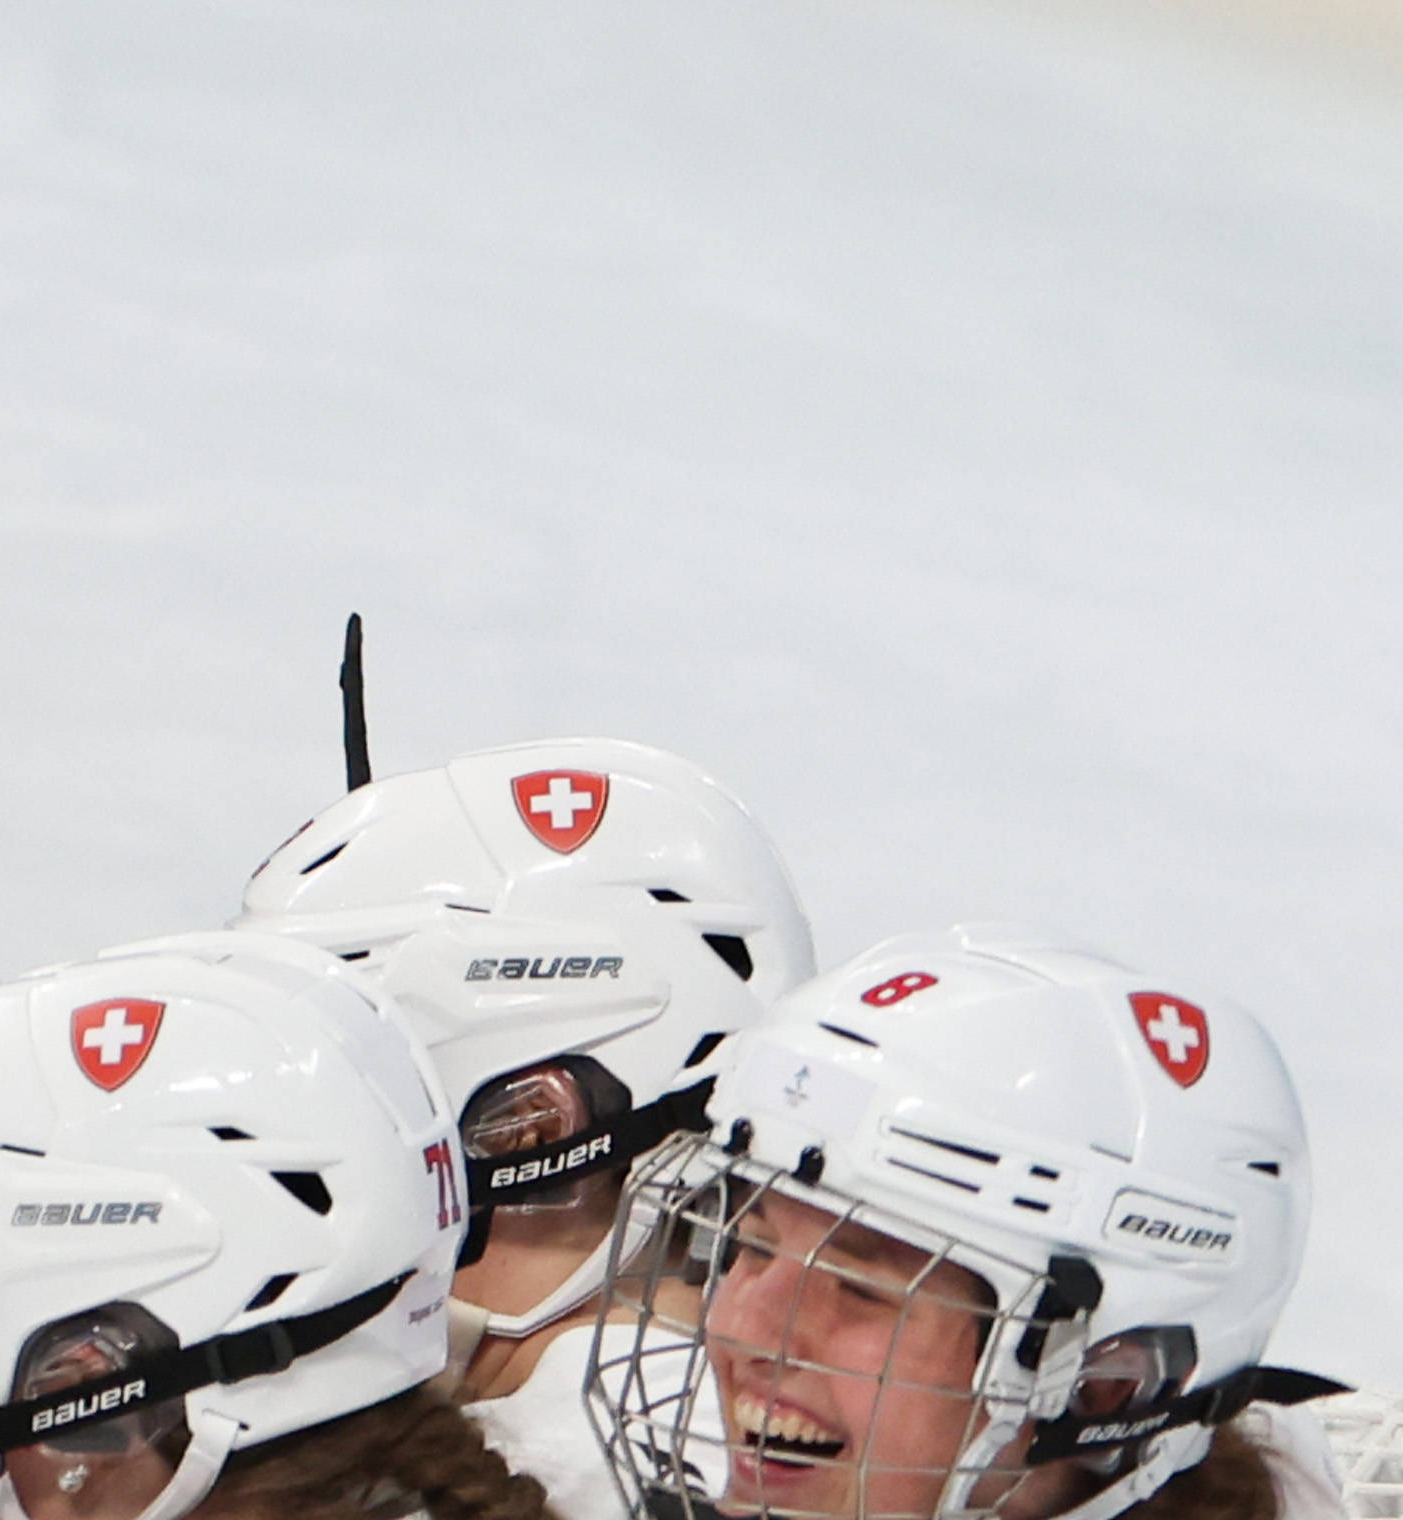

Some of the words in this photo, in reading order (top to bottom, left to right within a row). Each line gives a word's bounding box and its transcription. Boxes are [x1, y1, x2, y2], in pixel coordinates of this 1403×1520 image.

[464, 955, 624, 984] BAUER
[860, 971, 939, 1007] 8
[490, 1132, 613, 1190] BAUER
[423, 1137, 462, 1230] 71
[10, 1200, 163, 1229] BAUER
[1116, 1212, 1234, 1253] BAUER
[30, 1377, 147, 1433] BAUER
